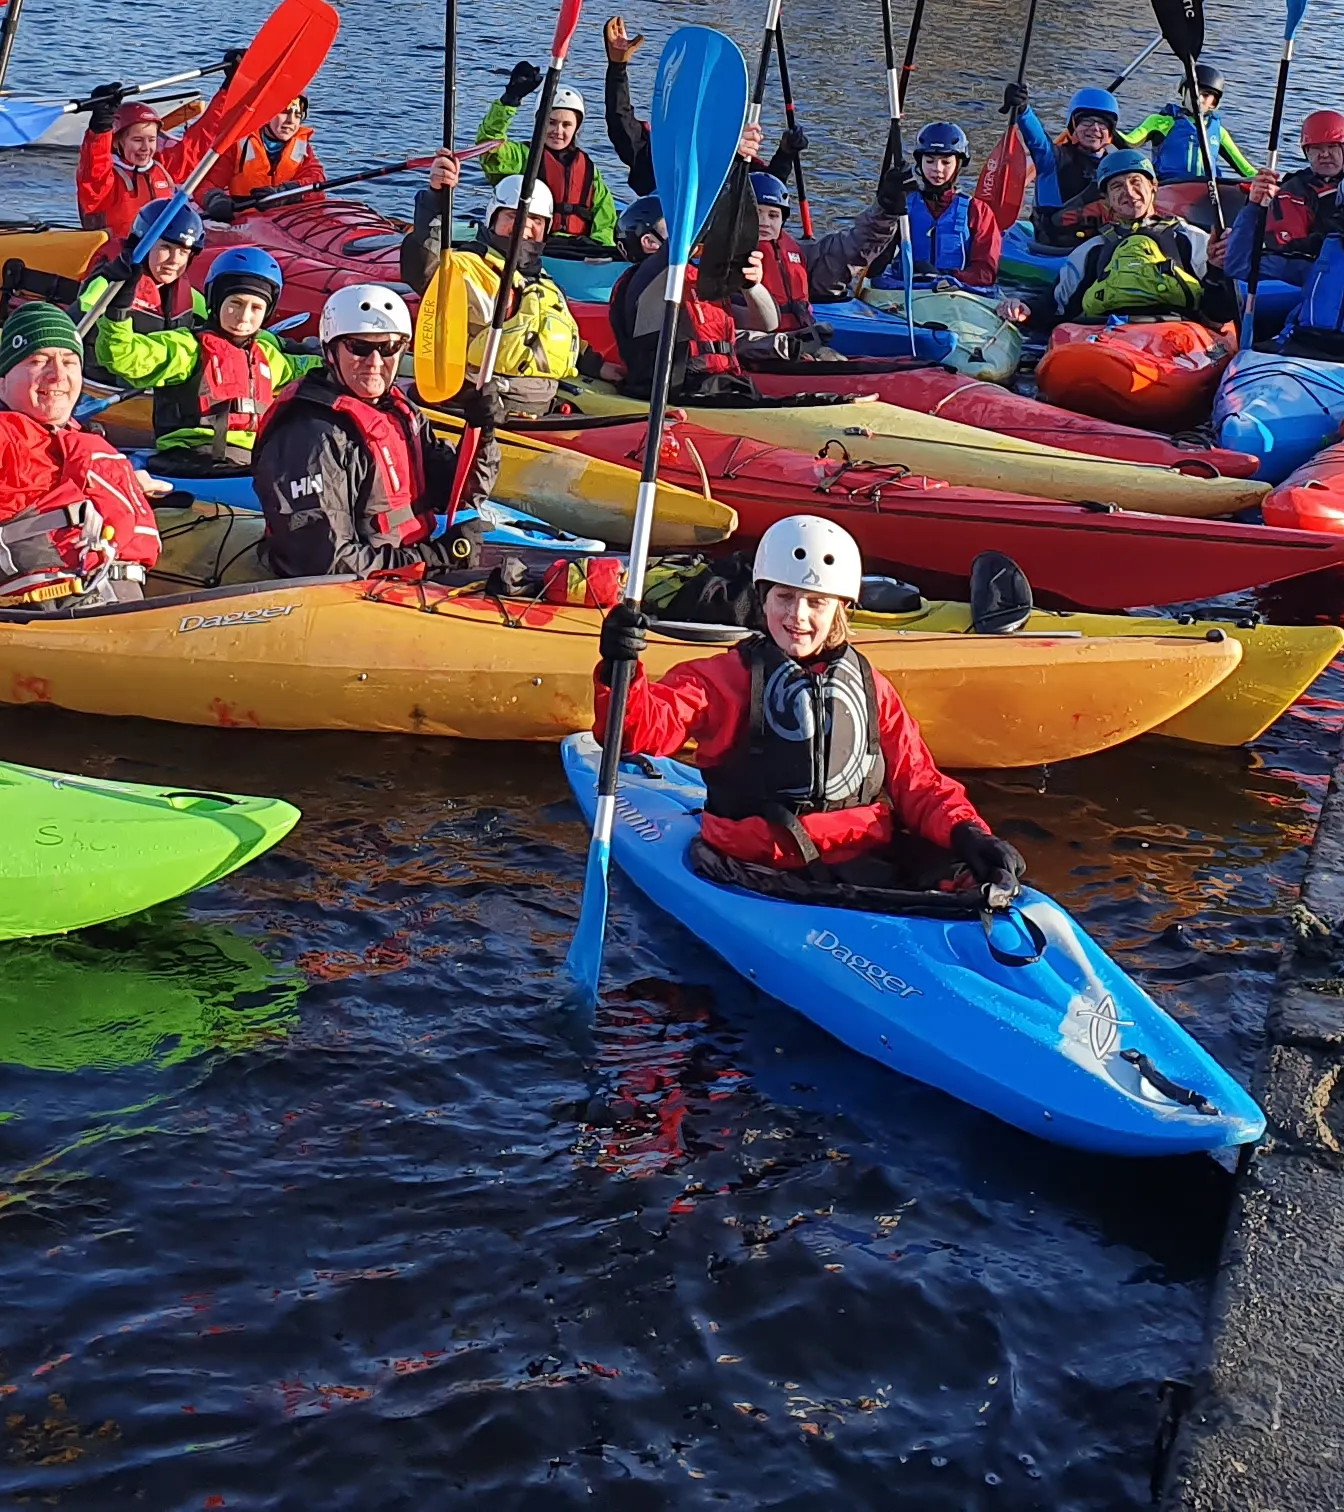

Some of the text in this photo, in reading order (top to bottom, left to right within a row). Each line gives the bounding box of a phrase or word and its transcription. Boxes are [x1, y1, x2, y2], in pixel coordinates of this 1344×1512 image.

[982, 158, 998, 197] WERNER
[422, 299, 436, 355] WERNER
[178, 604, 303, 633] Dagger
[812, 929, 924, 999] Dagger
